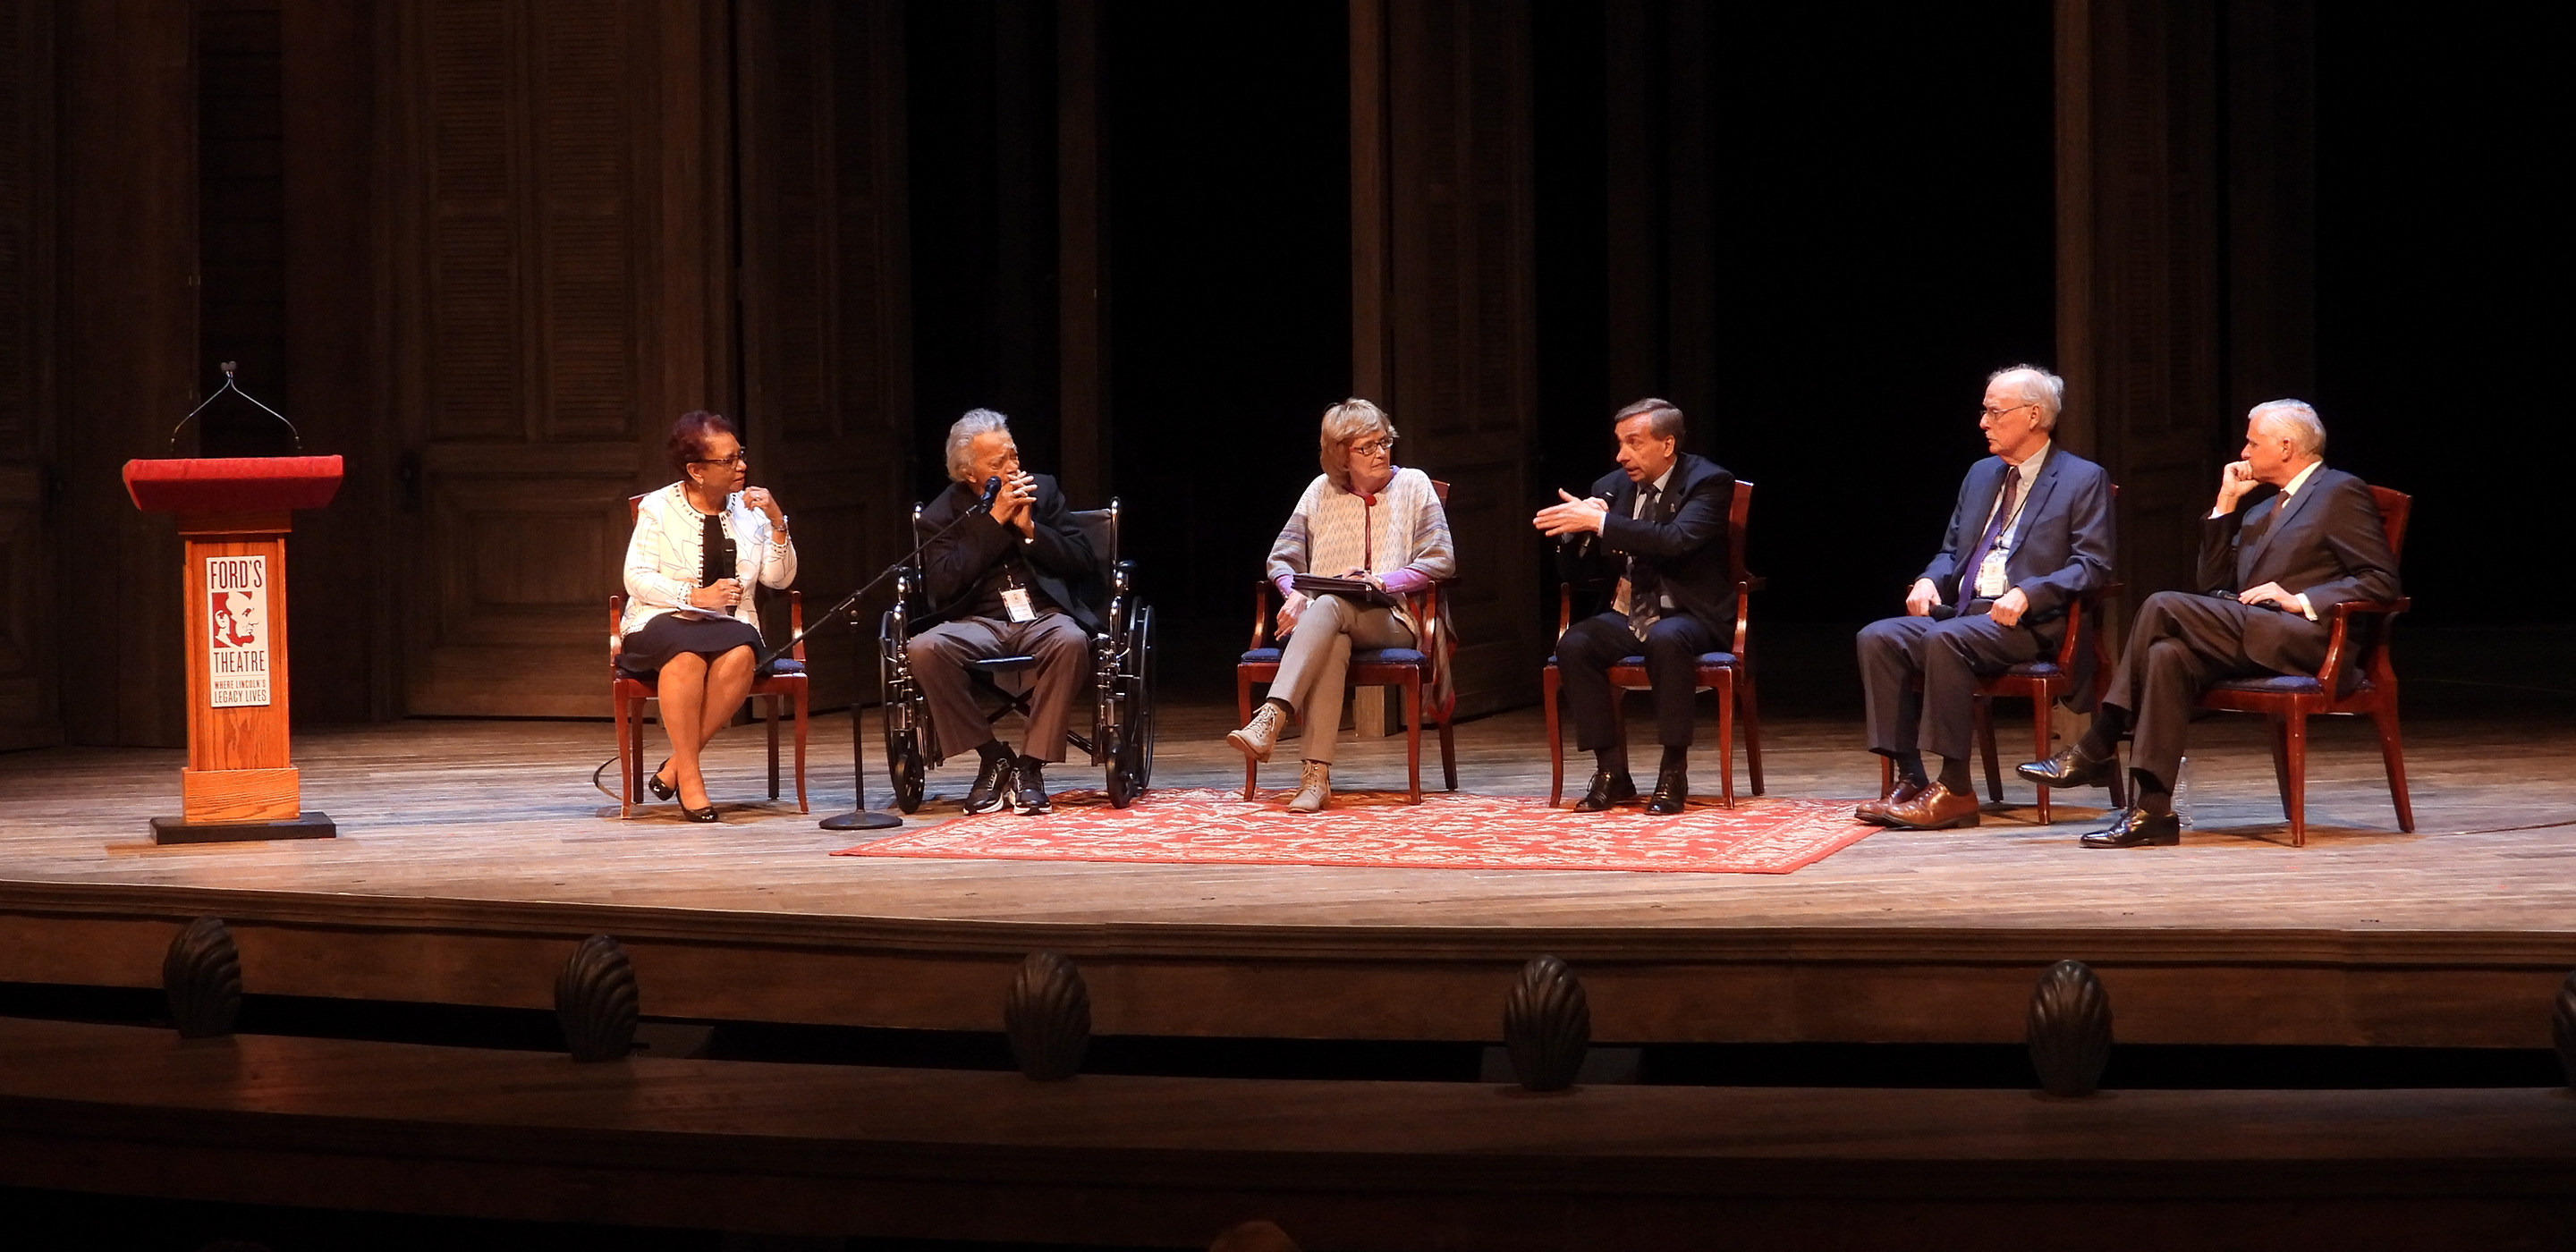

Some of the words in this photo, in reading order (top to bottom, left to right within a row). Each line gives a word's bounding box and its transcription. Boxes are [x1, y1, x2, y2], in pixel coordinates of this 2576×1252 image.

[210, 560, 262, 589] FORD'S
[214, 651, 265, 673] THEATRE
[215, 681, 233, 689] WHERE
[235, 680, 266, 689] LINCOLN'S
[215, 690, 242, 703] LEGACY
[245, 689, 267, 702] LIVES
